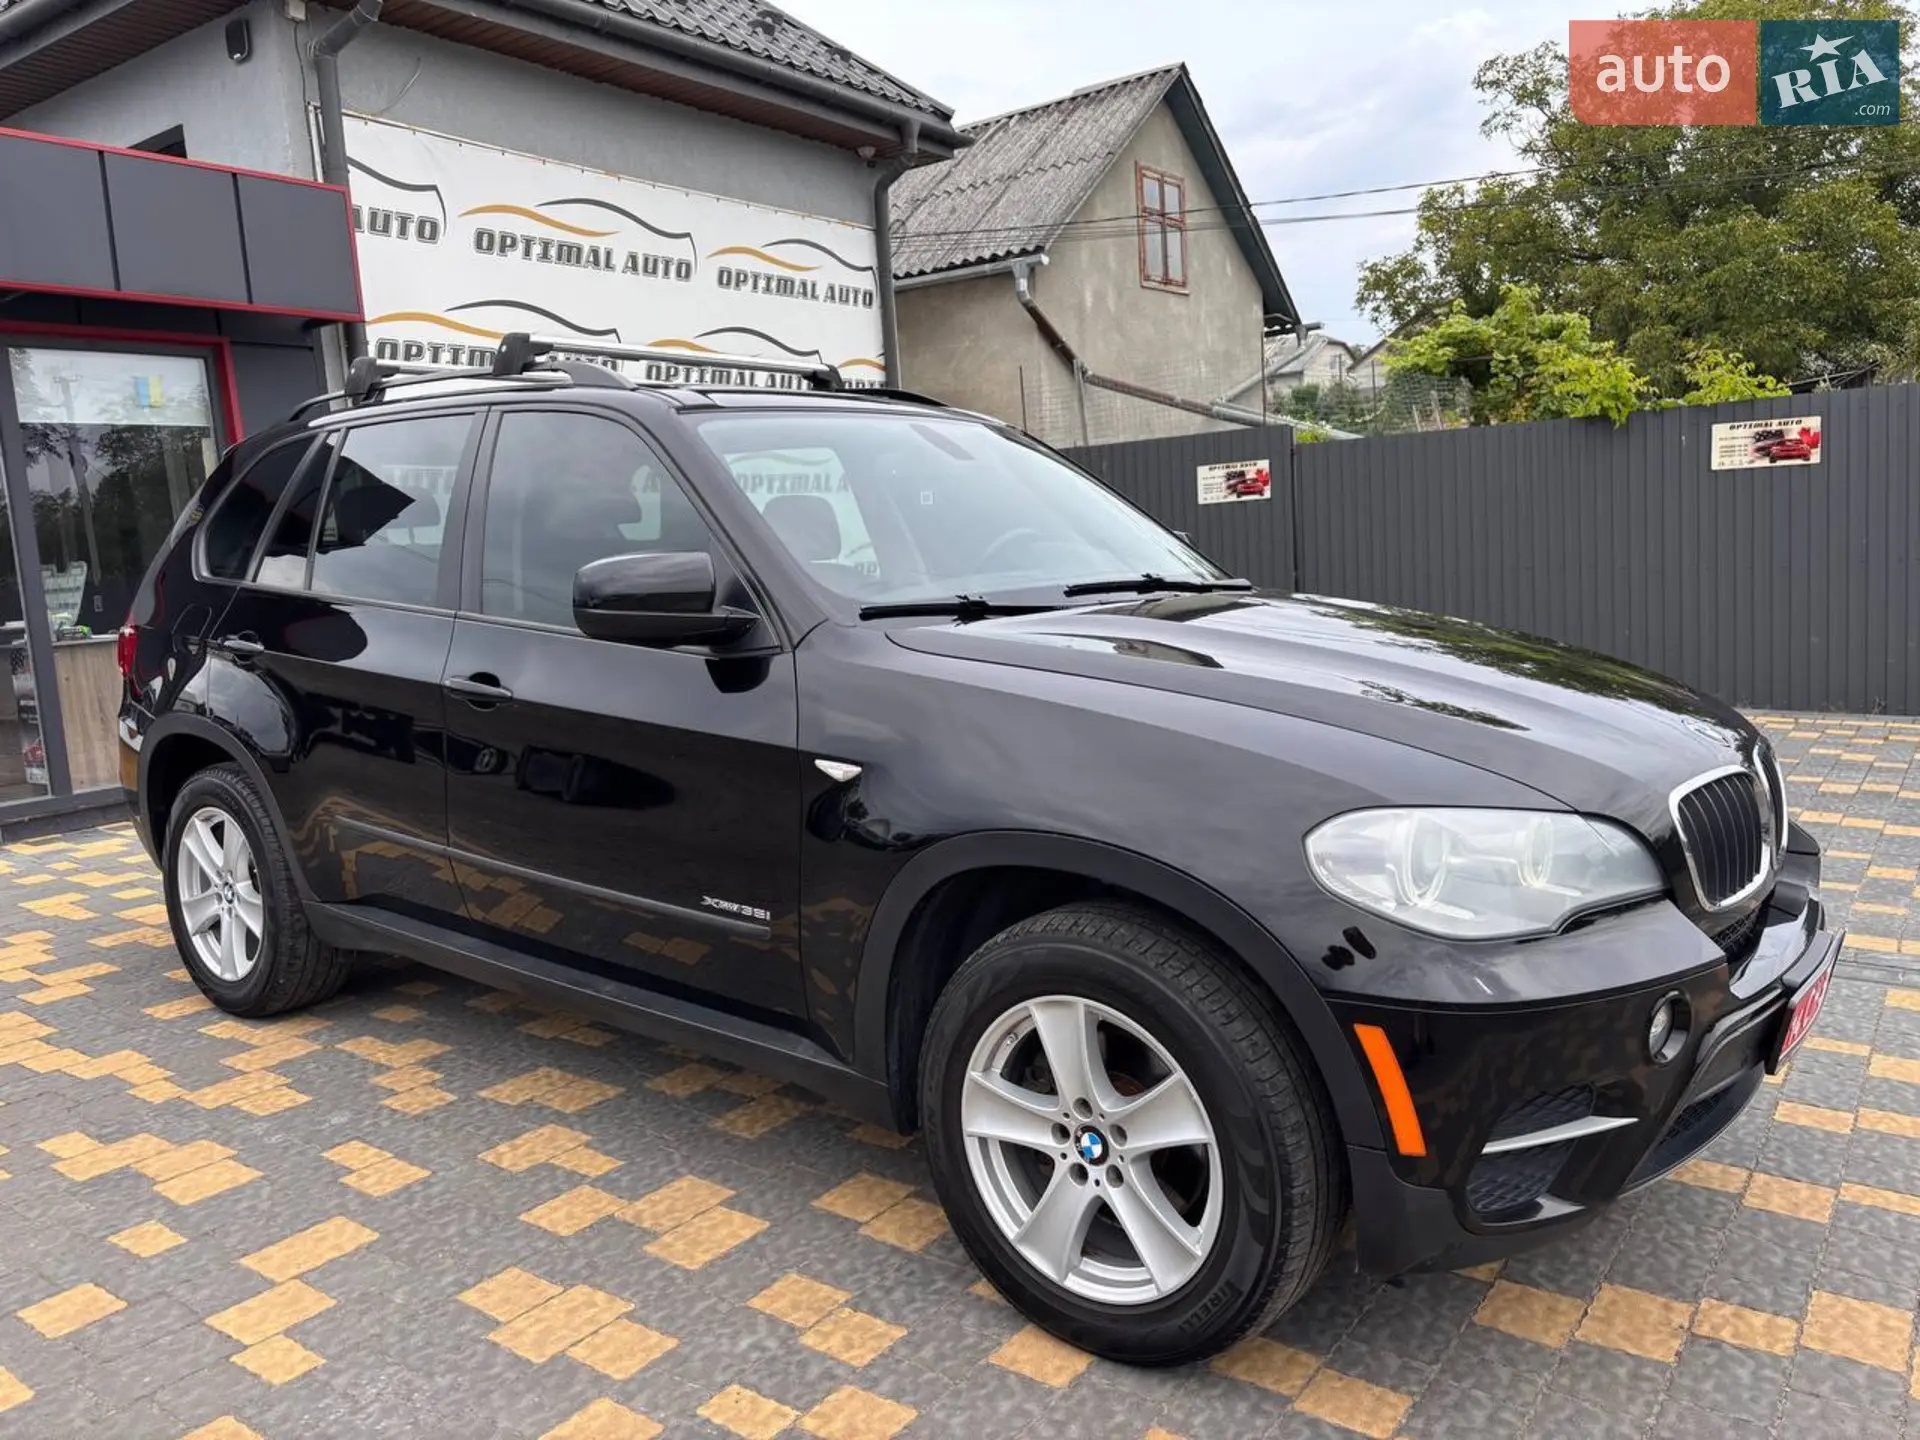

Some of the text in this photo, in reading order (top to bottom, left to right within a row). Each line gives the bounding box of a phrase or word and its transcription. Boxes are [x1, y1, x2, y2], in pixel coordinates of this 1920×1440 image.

[473, 227, 692, 282] OPTIMAL AUTO
[717, 266, 874, 309] OPTIMAL AUTO
